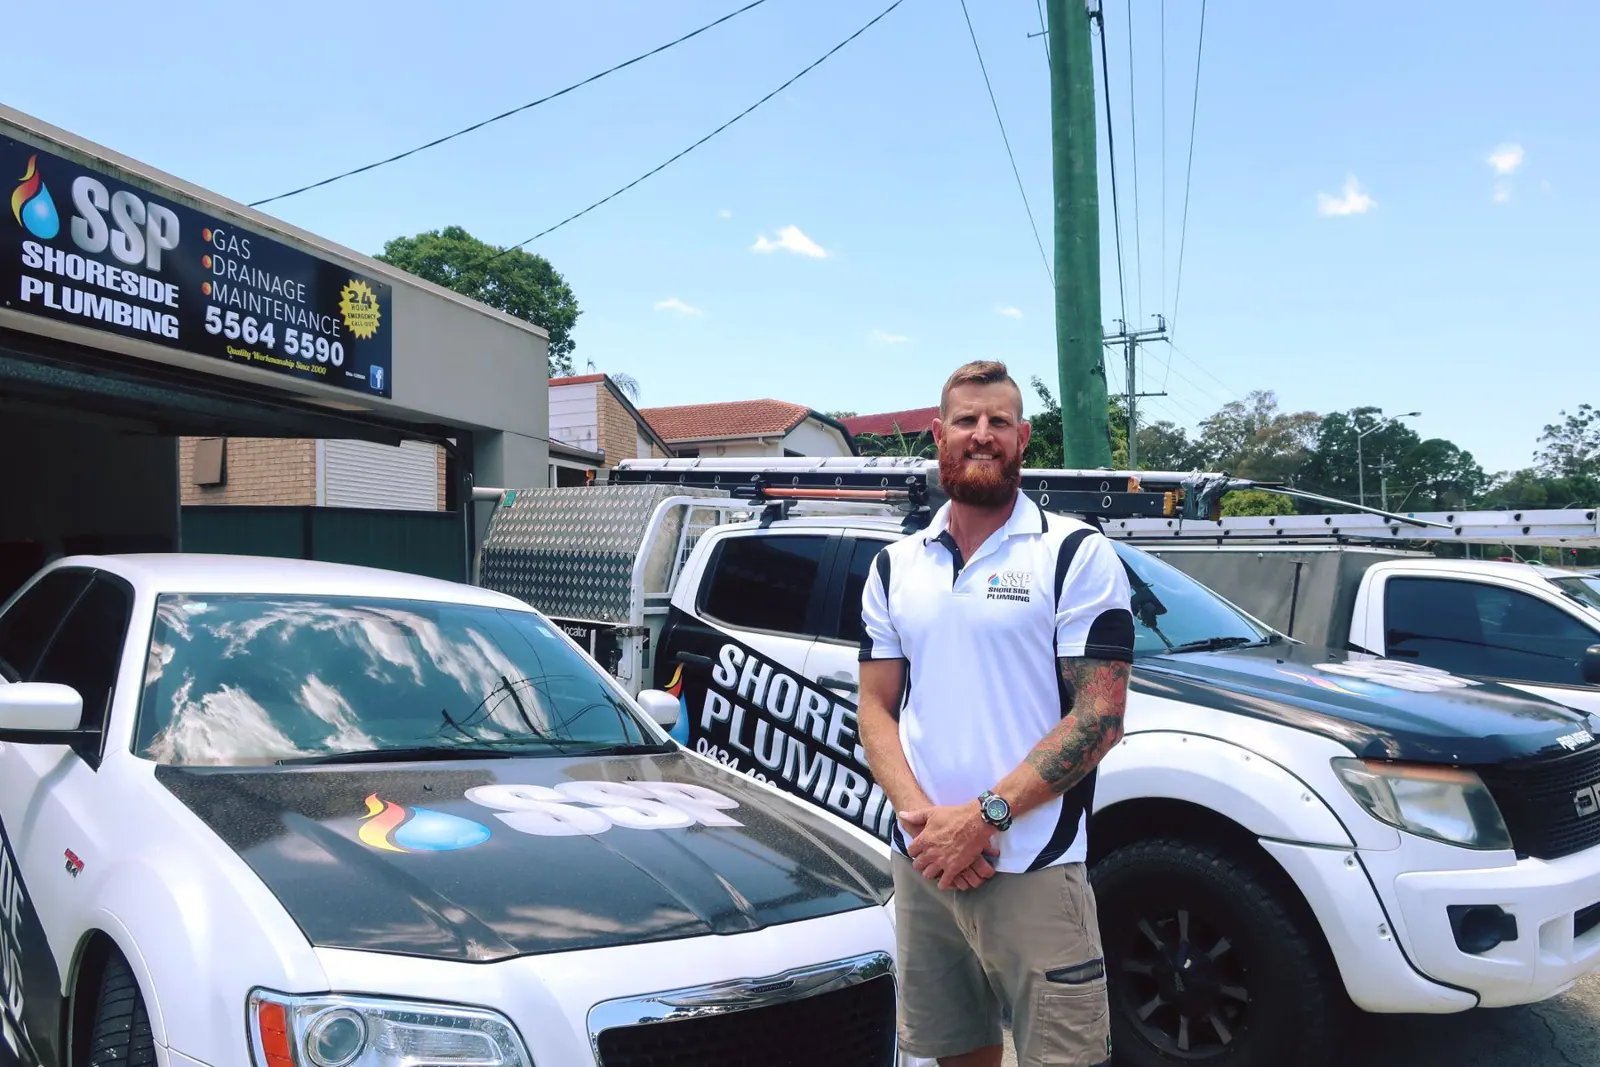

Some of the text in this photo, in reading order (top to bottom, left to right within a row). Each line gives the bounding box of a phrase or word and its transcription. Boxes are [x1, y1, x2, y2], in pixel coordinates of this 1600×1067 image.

[71, 176, 180, 272] SSP
[212, 229, 251, 260] GAS
[22, 240, 180, 308] SHORESIDE
[212, 254, 306, 304] DRAINAGE
[20, 275, 180, 339] PLUMBING
[212, 281, 341, 338] MAINTENANCE
[347, 312, 376, 320] EMERGENCY
[348, 290, 372, 309] 24
[204, 305, 344, 367] 5564 5590
[226, 345, 327, 375] Quality Workmanship Since 2000
[986, 593, 1031, 603] PLUMBING
[988, 587, 1030, 595] SHORESIDE
[1001, 570, 1032, 588] SSP
[712, 643, 868, 770] SHORE
[464, 781, 745, 836] SSP
